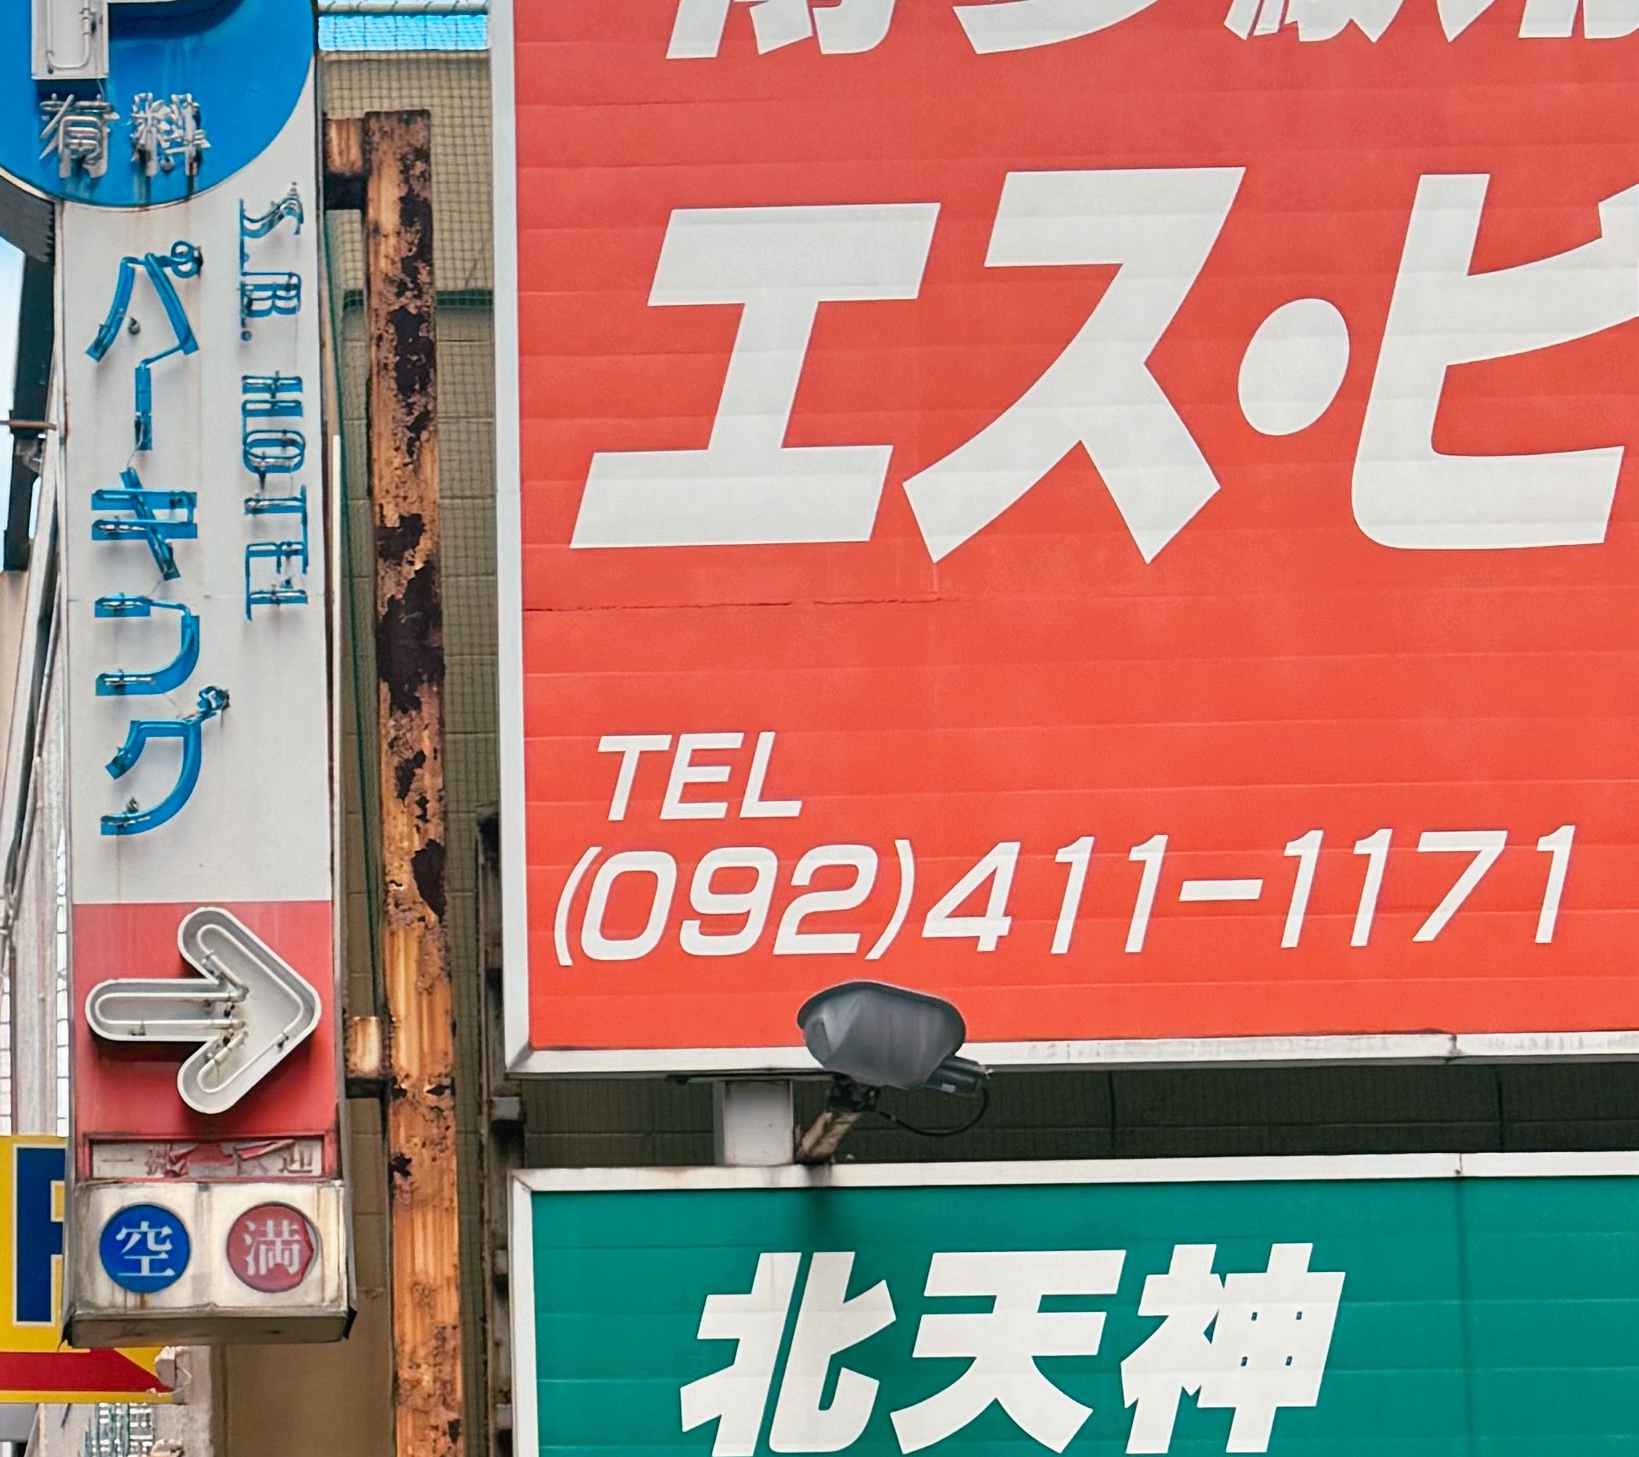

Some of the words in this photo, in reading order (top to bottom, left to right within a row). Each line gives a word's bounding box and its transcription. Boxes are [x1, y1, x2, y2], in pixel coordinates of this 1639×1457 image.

[38, 92, 211, 178] 有料
[84, 239, 231, 837] パーキング
[242, 371, 309, 621] HOTEL
[596, 731, 802, 822] TEL
[115, 1220, 176, 1278] 空
[243, 1219, 303, 1277] 満
[679, 1242, 1347, 1457] 北天神
